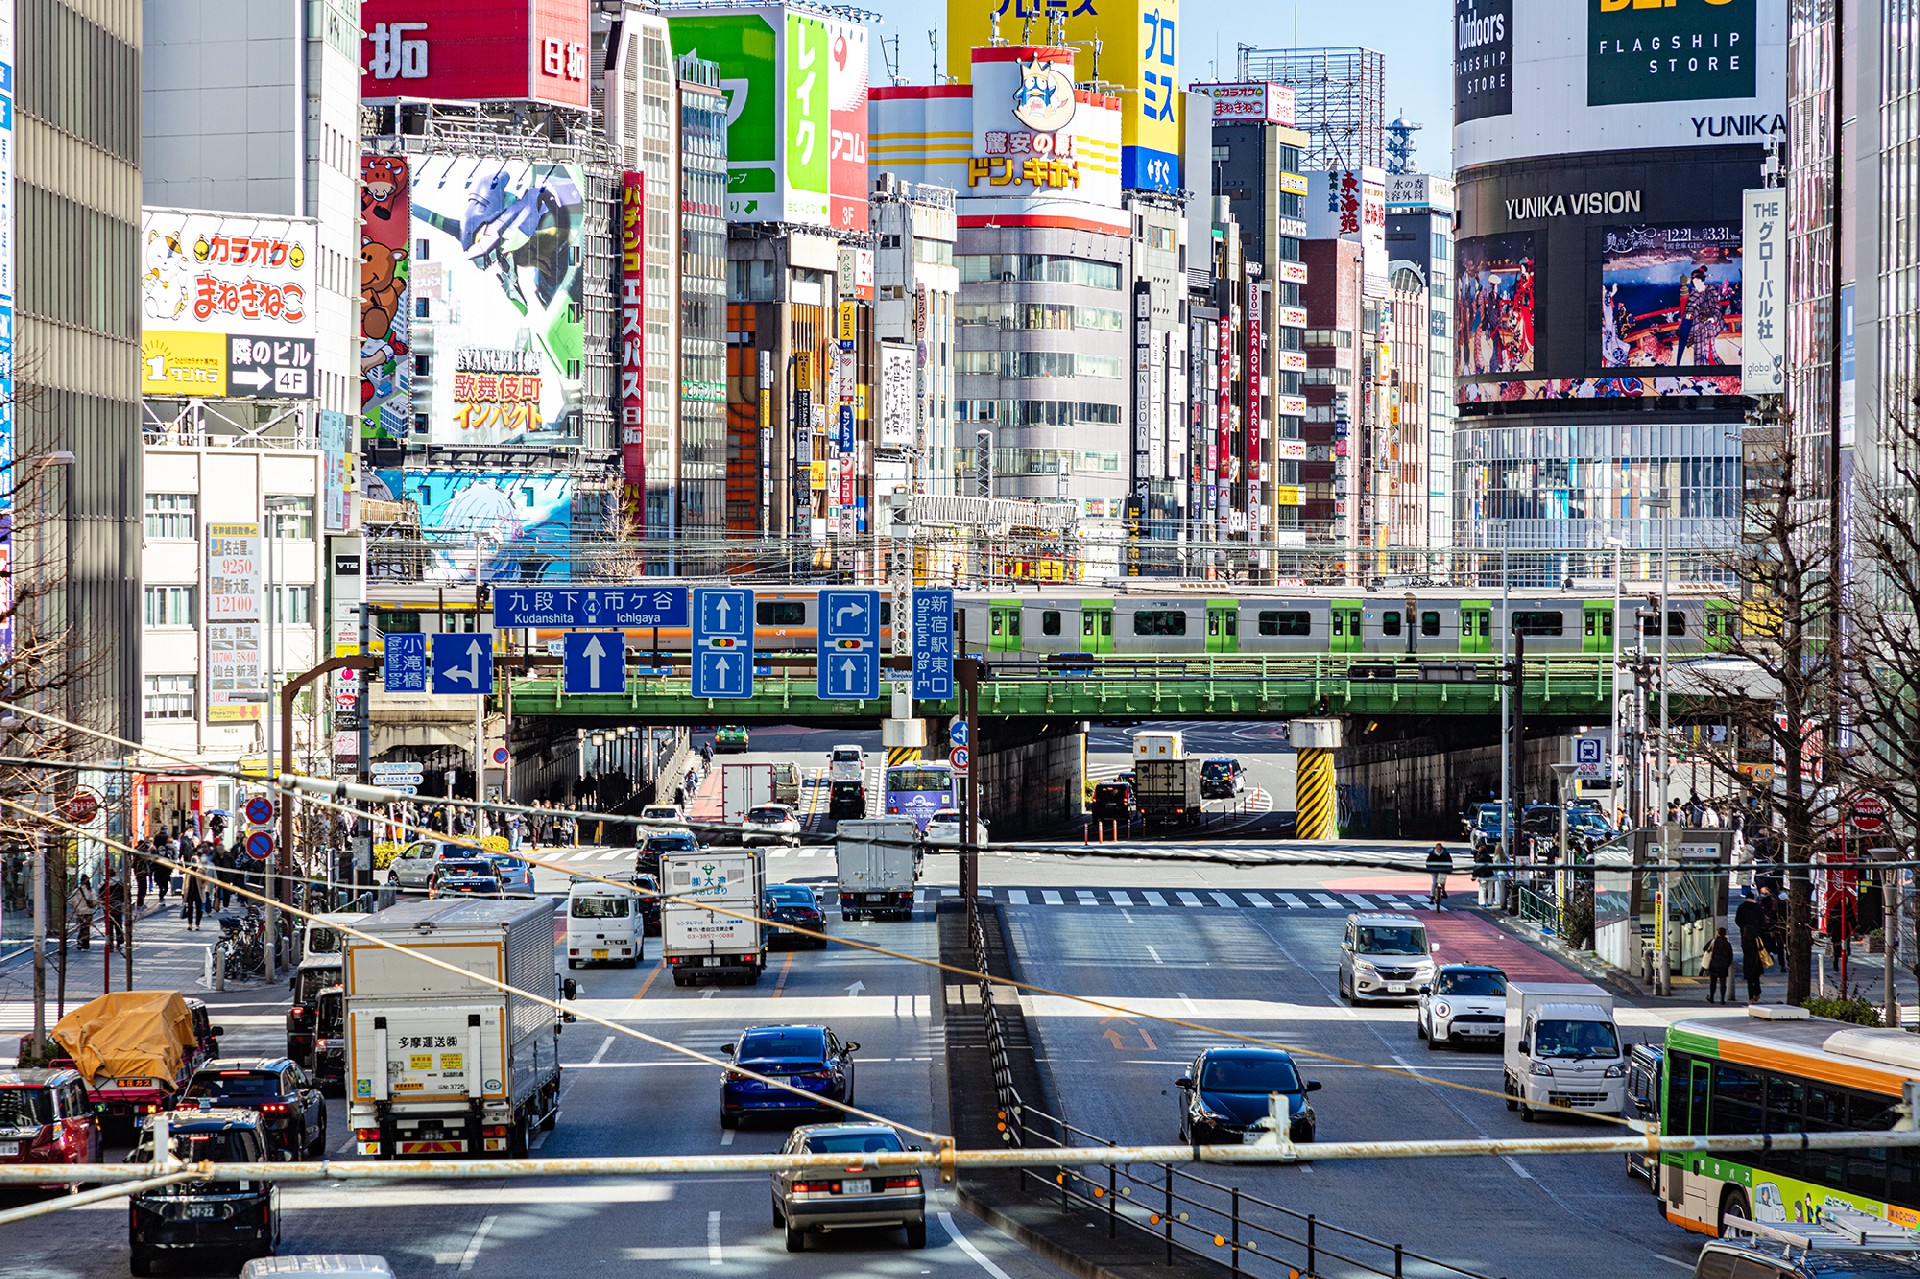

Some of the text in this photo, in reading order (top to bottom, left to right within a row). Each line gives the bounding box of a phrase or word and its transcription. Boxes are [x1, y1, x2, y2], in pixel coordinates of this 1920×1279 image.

[1458, 13, 1505, 51] Outdoors
[1600, 32, 1740, 54] FLAGSHIP
[369, 23, 428, 79] 拓
[545, 36, 585, 80] 日拓
[1456, 52, 1506, 76] FLAGSHIP
[1650, 55, 1740, 74] STORE
[796, 24, 816, 165] レイク
[1221, 88, 1256, 96] カラオケ
[1467, 73, 1506, 94] STORE
[1214, 99, 1262, 116] まねきねこ
[1691, 114, 1786, 138] YUNIKA
[832, 129, 865, 163] アコム
[1393, 179, 1424, 189] 水の森
[842, 206, 854, 226] 3F
[1505, 190, 1641, 220] YUNIKA VISION
[1753, 202, 1778, 218] THE
[1281, 218, 1307, 237] DARTS
[1707, 227, 1729, 241] 3.31
[210, 235, 290, 267] カラオケ
[842, 254, 852, 290] 戸谷ビル
[1757, 221, 1774, 340] グローバル社
[193, 272, 305, 322] まねきねこ
[843, 305, 851, 337] プロミス
[232, 339, 311, 366] 隣のビル
[1251, 321, 1259, 383] KARAOKE
[170, 367, 218, 383] ワンカラ
[279, 372, 303, 390] 4F
[1748, 362, 1771, 379] global
[454, 374, 543, 402] 歌舞伎町
[453, 402, 543, 430] インパクト
[1139, 374, 1147, 449] KIBORI
[1251, 402, 1259, 445] PARTY
[829, 441, 839, 458] 7F
[842, 475, 850, 497] アコム
[225, 540, 247, 556] 名古屋
[222, 559, 252, 574] 9250
[225, 579, 249, 594] 新大阪
[216, 596, 252, 612] 12100
[509, 591, 579, 611] 九段下
[514, 614, 661, 626] Kudanshita Ichigaya
[917, 598, 930, 648] Shinjuku
[212, 627, 251, 639] 京都 静岡
[775, 629, 786, 637] JR
[930, 595, 949, 693] 新宿駅東口
[212, 652, 256, 663] 11700 5840
[388, 636, 402, 671] Otakibashi
[403, 638, 422, 688] 小滝橋
[213, 665, 257, 677] 仙台 新潟
[117, 1079, 151, 1088] 高圧ガス
